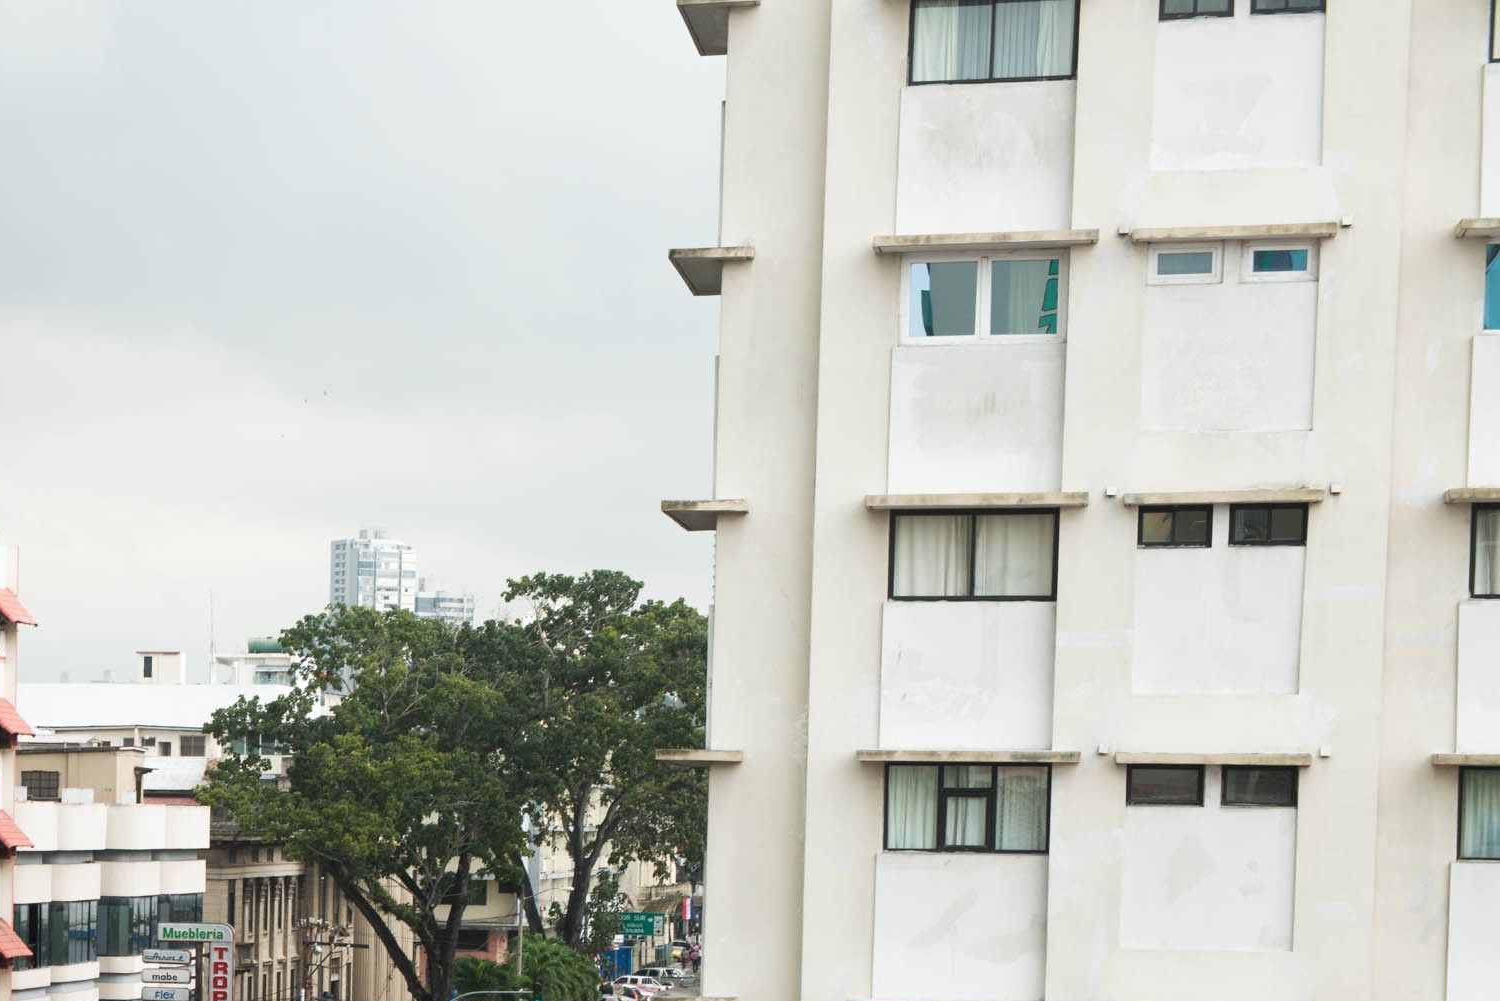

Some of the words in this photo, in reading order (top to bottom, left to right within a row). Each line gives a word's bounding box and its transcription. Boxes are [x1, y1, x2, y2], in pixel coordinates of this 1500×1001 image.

[163, 927, 224, 940] Muebleria
[151, 972, 178, 981] mabe
[154, 990, 176, 1001] Flex
